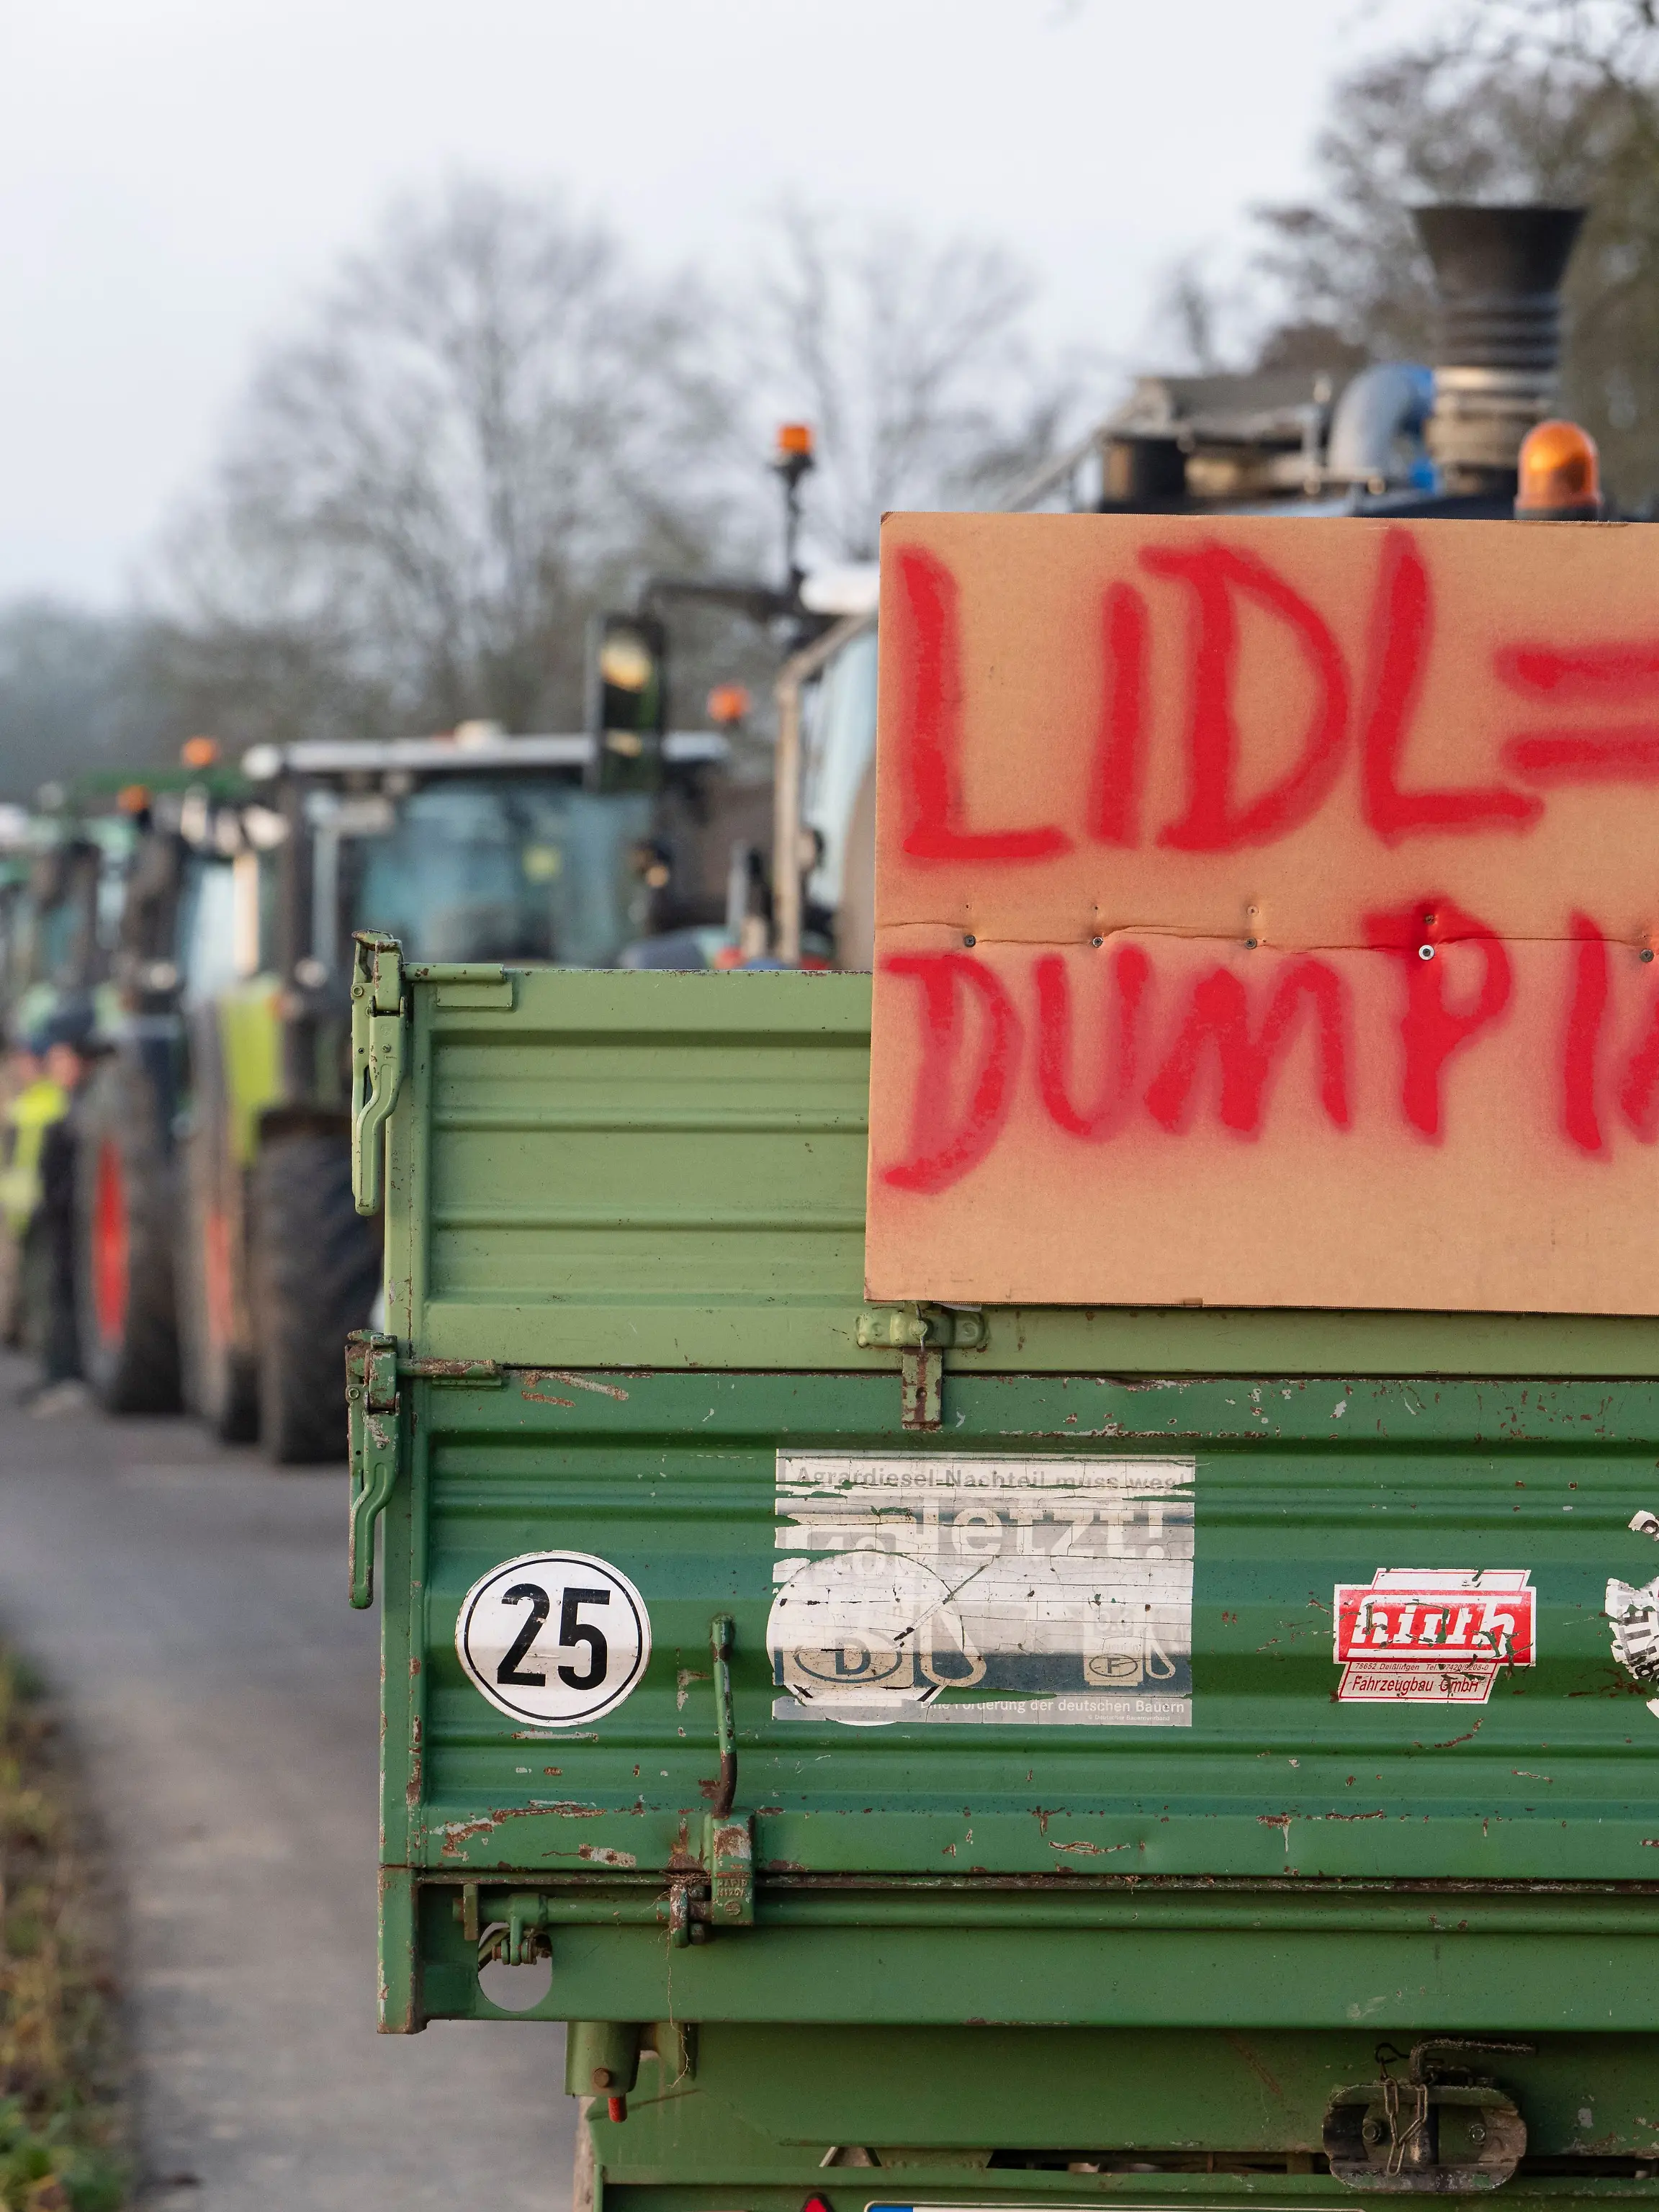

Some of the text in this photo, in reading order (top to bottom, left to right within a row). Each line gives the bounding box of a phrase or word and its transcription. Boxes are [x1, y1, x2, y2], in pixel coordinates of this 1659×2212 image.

[878, 895, 1659, 1195] DUMPI
[796, 1466, 1046, 1490] Agrardiesel-Nachteil
[1056, 1475, 1119, 1490] muss
[497, 1583, 611, 1691] 25
[835, 1636, 871, 1676] D
[1107, 1657, 1121, 1674] F
[1379, 1663, 1420, 1671] Deißlingen
[1352, 1675, 1480, 1696] Fahrzeugbau GmbH
[1030, 1699, 1053, 1711] der
[1058, 1699, 1130, 1712] deutschen
[1136, 1699, 1184, 1713] Bauern
